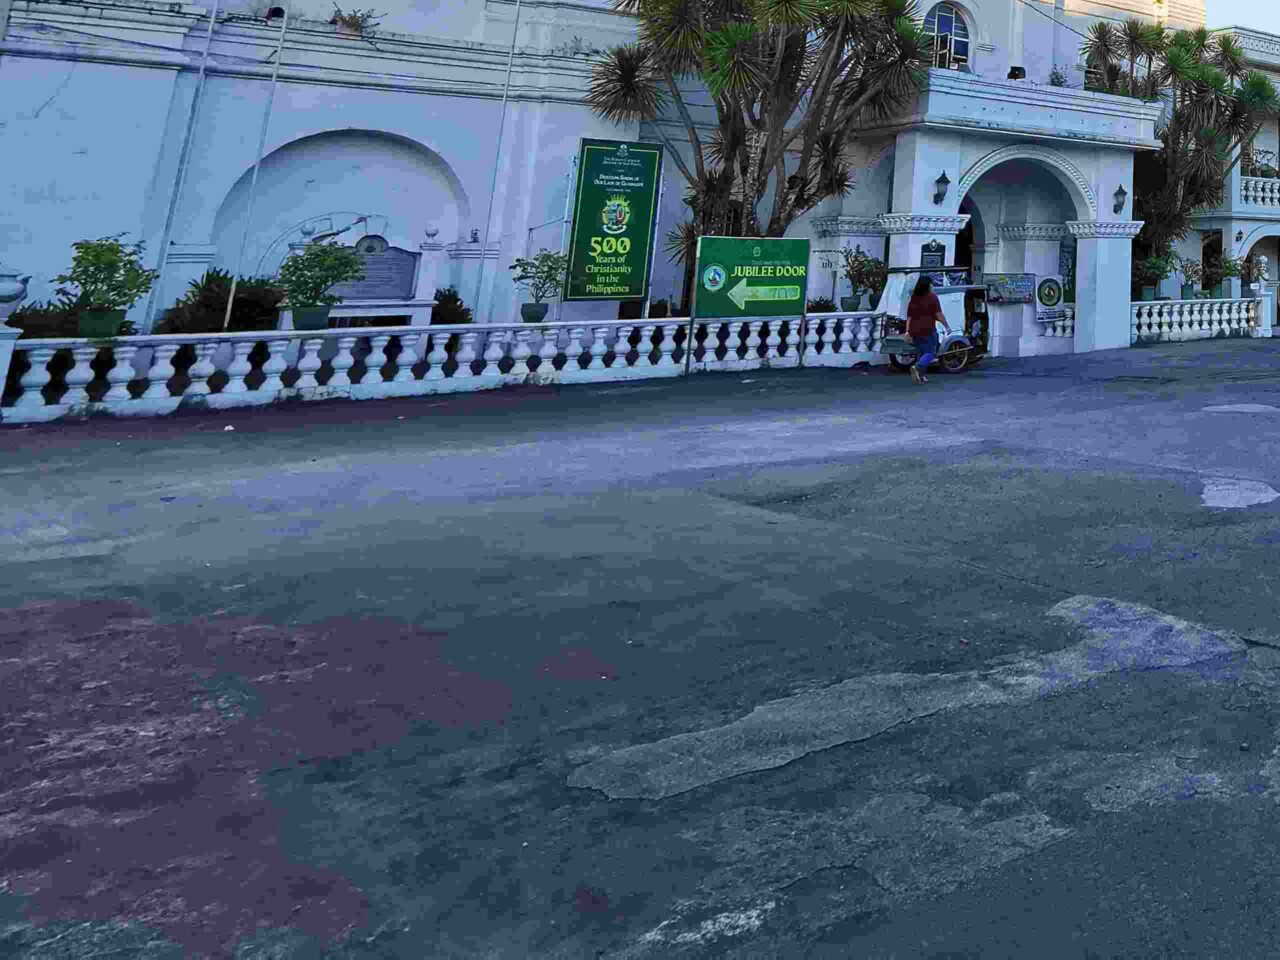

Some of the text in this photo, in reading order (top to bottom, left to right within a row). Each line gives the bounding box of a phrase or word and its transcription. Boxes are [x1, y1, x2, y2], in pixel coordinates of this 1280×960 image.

[588, 237, 631, 256] 500
[595, 255, 627, 263] Years of
[585, 264, 632, 274] Christianity
[731, 266, 806, 276] JUBILEE DOOR
[597, 275, 605, 283] in
[585, 284, 630, 294] Philippines
